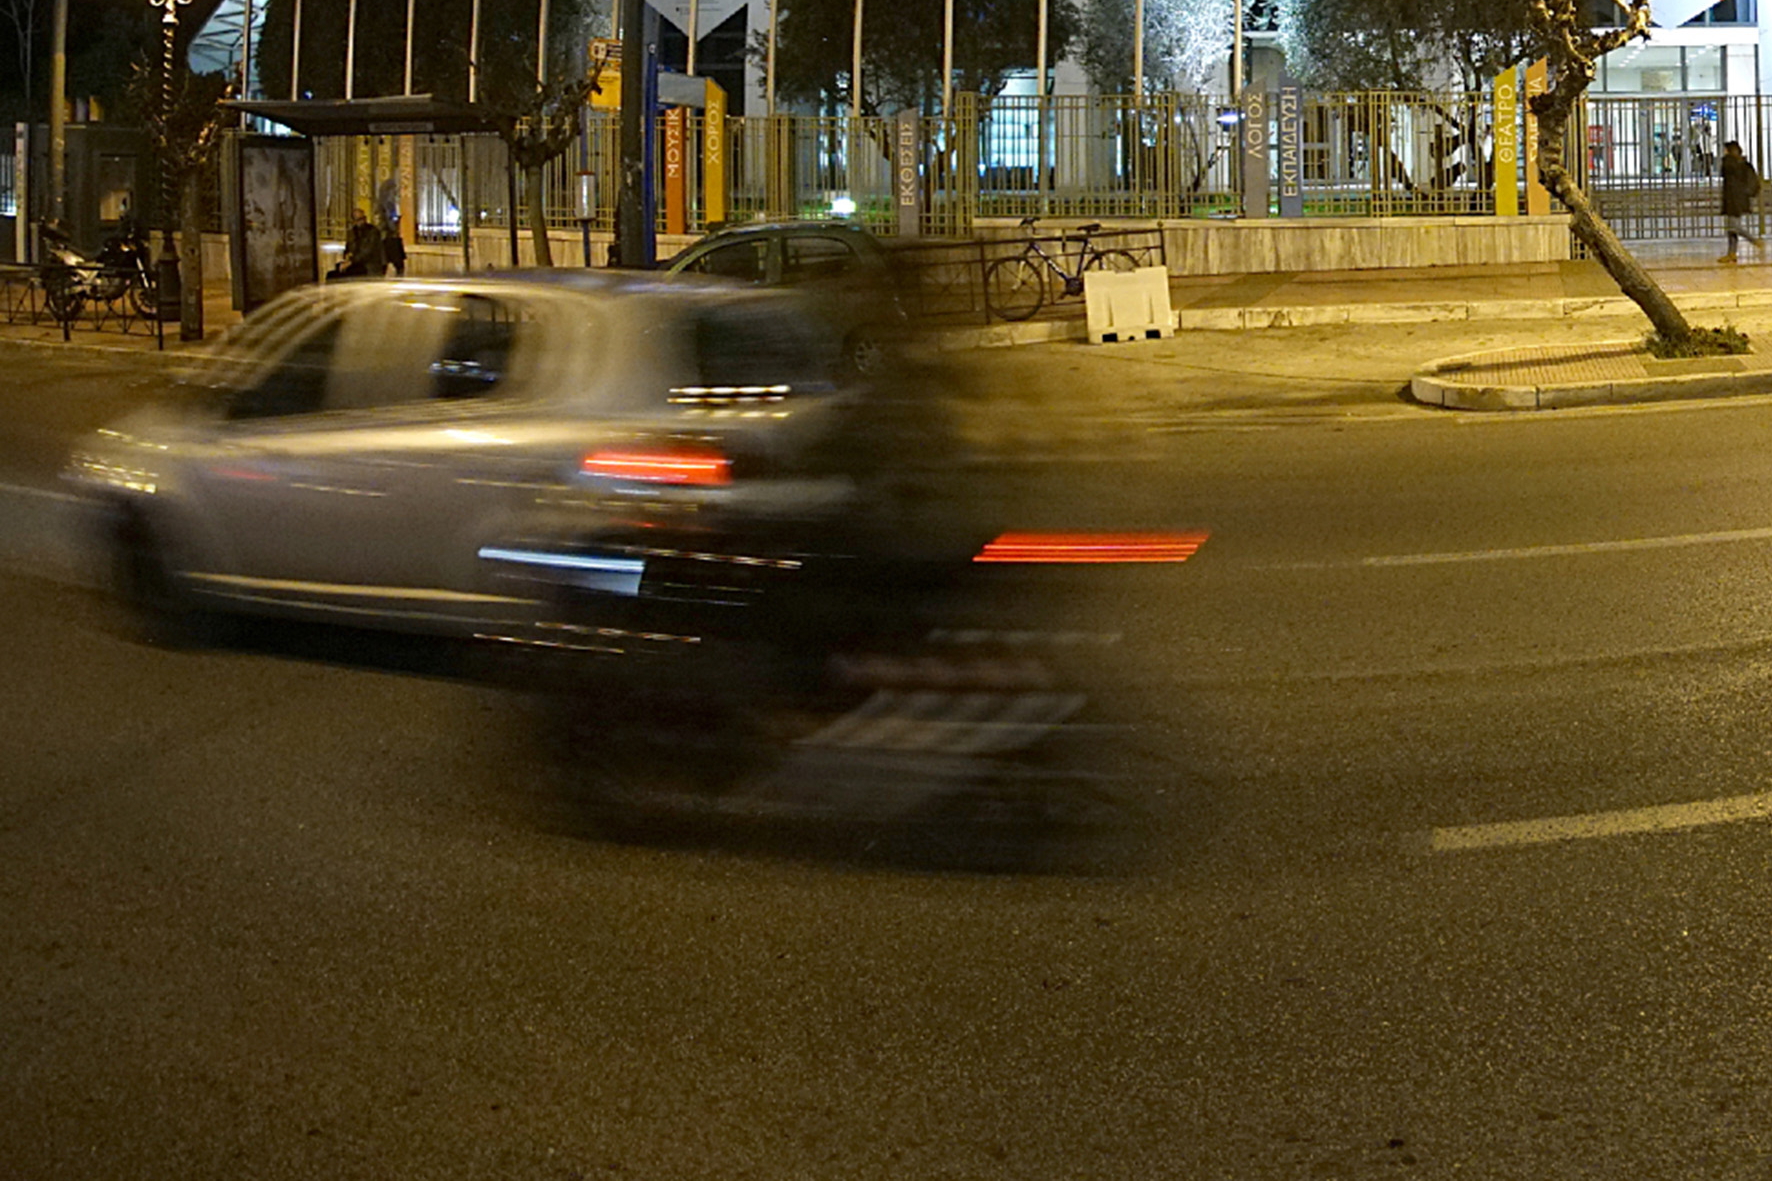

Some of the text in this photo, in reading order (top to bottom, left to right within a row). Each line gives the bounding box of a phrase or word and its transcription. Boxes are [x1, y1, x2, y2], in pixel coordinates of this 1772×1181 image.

[667, 108, 680, 178] ΜΟΥΣΙΚ
[707, 100, 720, 165] ΧΟΡΟΣ
[1247, 92, 1263, 159] ΛΟΓΟΣ
[1281, 86, 1298, 197] ΕΚΠΑΙΔΕΥΣΗ
[1498, 84, 1514, 164] ΘΕΑΤΡΟ
[900, 121, 915, 206] ΕΚΘΕΣΕΙΣ
